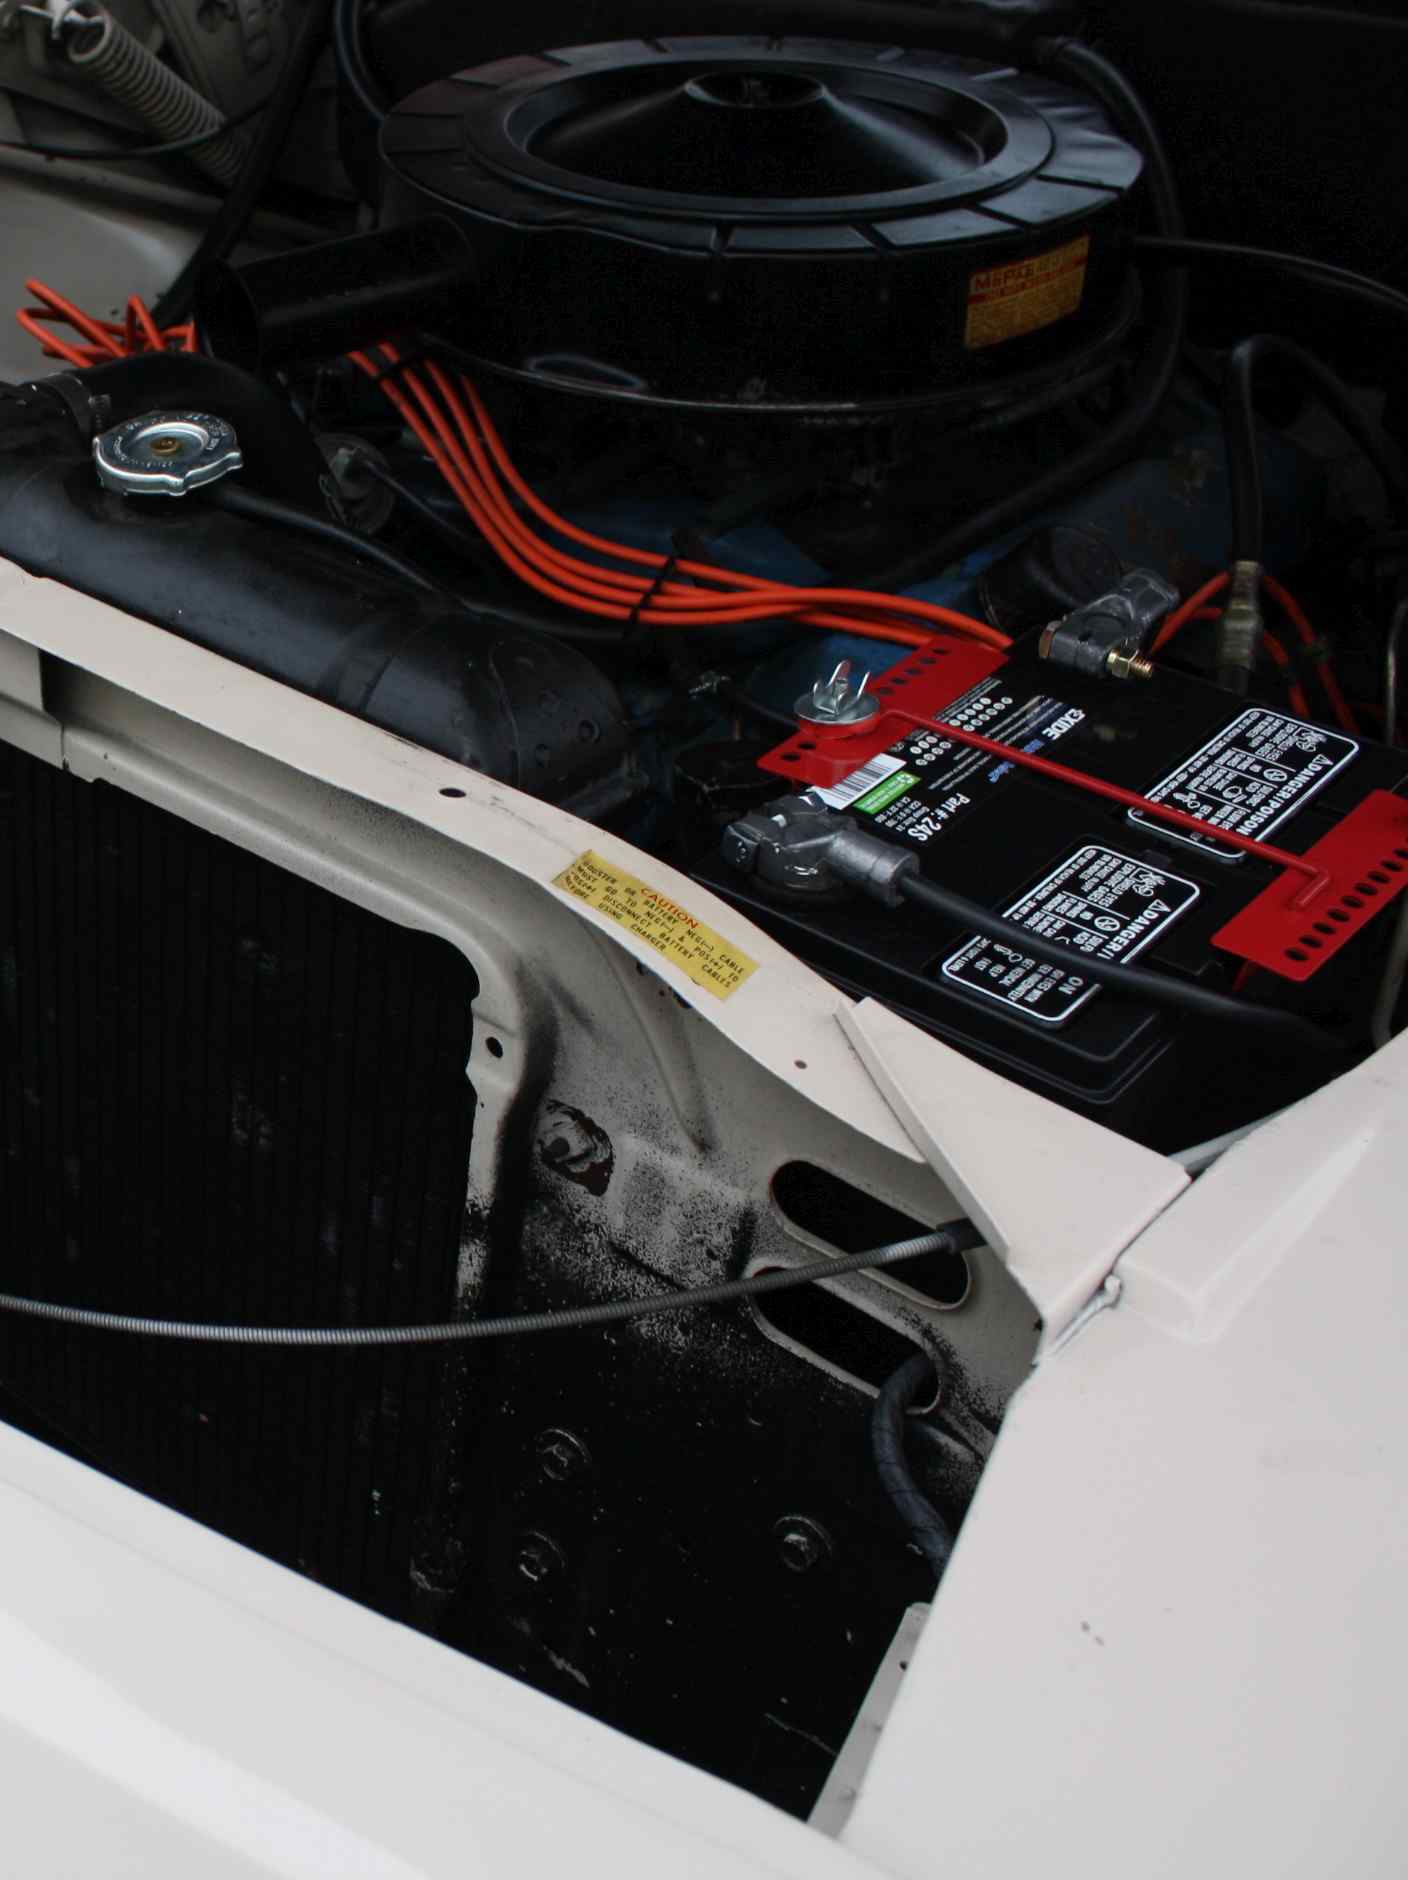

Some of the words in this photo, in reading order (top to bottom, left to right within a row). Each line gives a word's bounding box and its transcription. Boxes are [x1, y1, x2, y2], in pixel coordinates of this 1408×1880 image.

[1042, 708, 1086, 740] EXIDE
[942, 792, 971, 814] Part
[1236, 762, 1323, 836] DANGER/POISON
[907, 818, 942, 841] 24S
[598, 902, 625, 920] USING
[630, 923, 667, 951] CHARGER
[640, 887, 700, 929] CAUTION
[602, 894, 652, 928] DISCONNECT
[659, 932, 695, 959] BATTERY
[702, 963, 732, 988] CABLES
[643, 899, 678, 924] BATTERY
[719, 954, 744, 974] CABLE
[1058, 909, 1159, 995] DANGER/ON
[728, 971, 739, 982] TO
